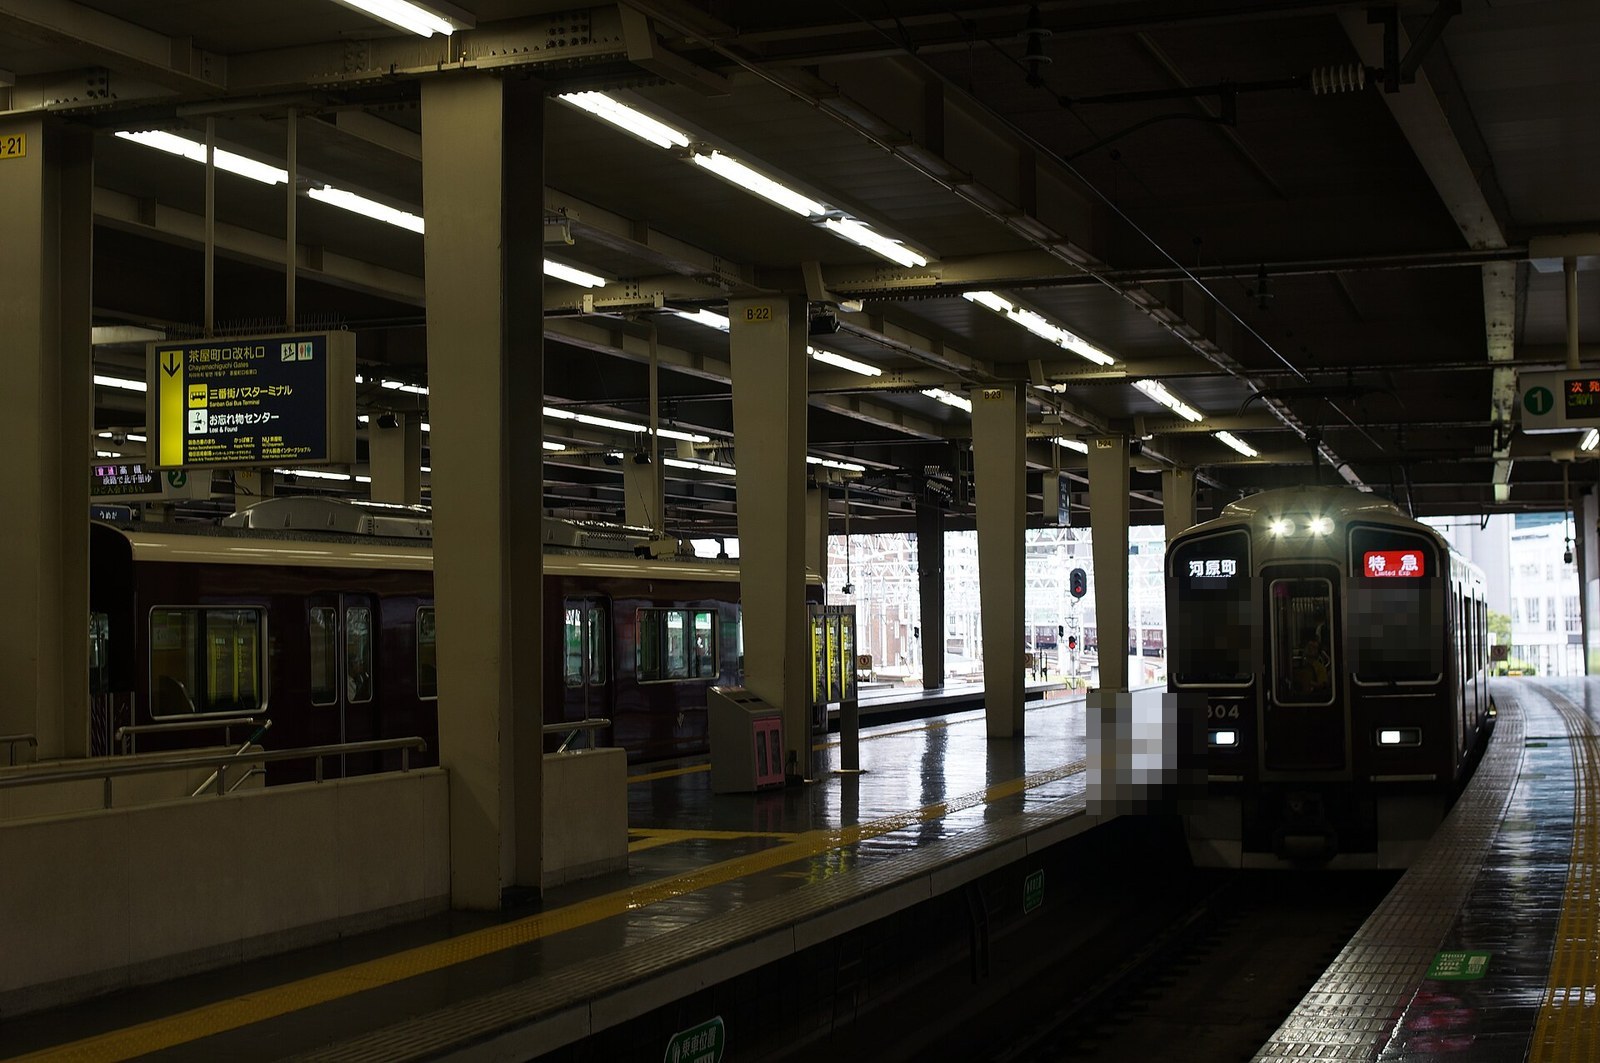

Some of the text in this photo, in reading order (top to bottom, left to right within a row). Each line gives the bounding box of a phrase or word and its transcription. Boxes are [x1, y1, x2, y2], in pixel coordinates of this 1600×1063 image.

[0, 137, 21, 155] -21
[747, 308, 769, 320] B-22
[188, 345, 266, 363] 茶屋町口改札口
[188, 361, 249, 372] Chayamachiguchi Gates
[209, 384, 293, 400] 三番街バスターミナル
[209, 411, 280, 426] お忘れ物センター
[1189, 559, 1236, 576] 河原町
[1368, 554, 1419, 572] 特急
